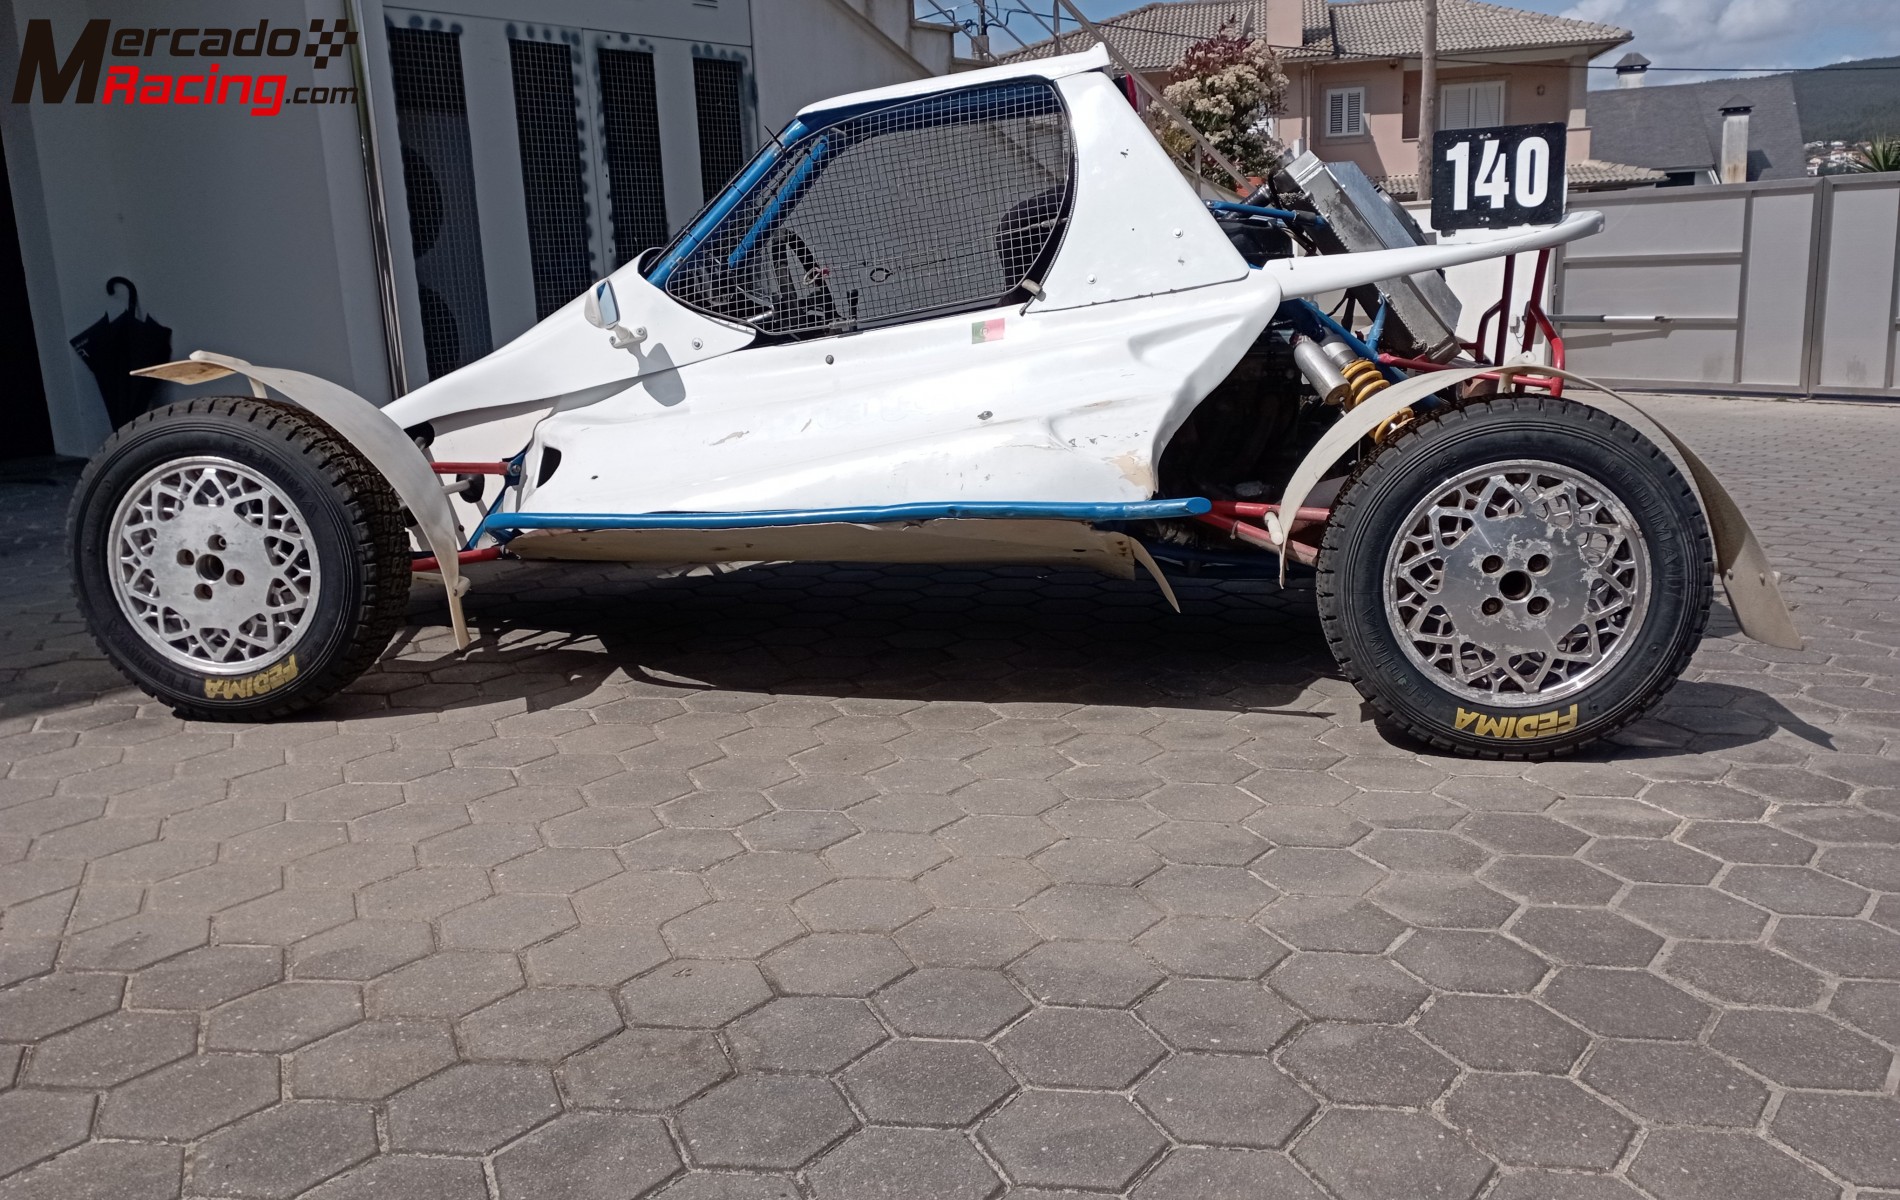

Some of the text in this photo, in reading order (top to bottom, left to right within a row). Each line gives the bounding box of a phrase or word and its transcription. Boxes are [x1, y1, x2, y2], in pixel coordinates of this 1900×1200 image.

[1446, 136, 1550, 211] 140
[1602, 459, 1680, 567] FEDIMA
[204, 653, 299, 700] FEDIMA
[1454, 703, 1578, 739] FEDIMA
